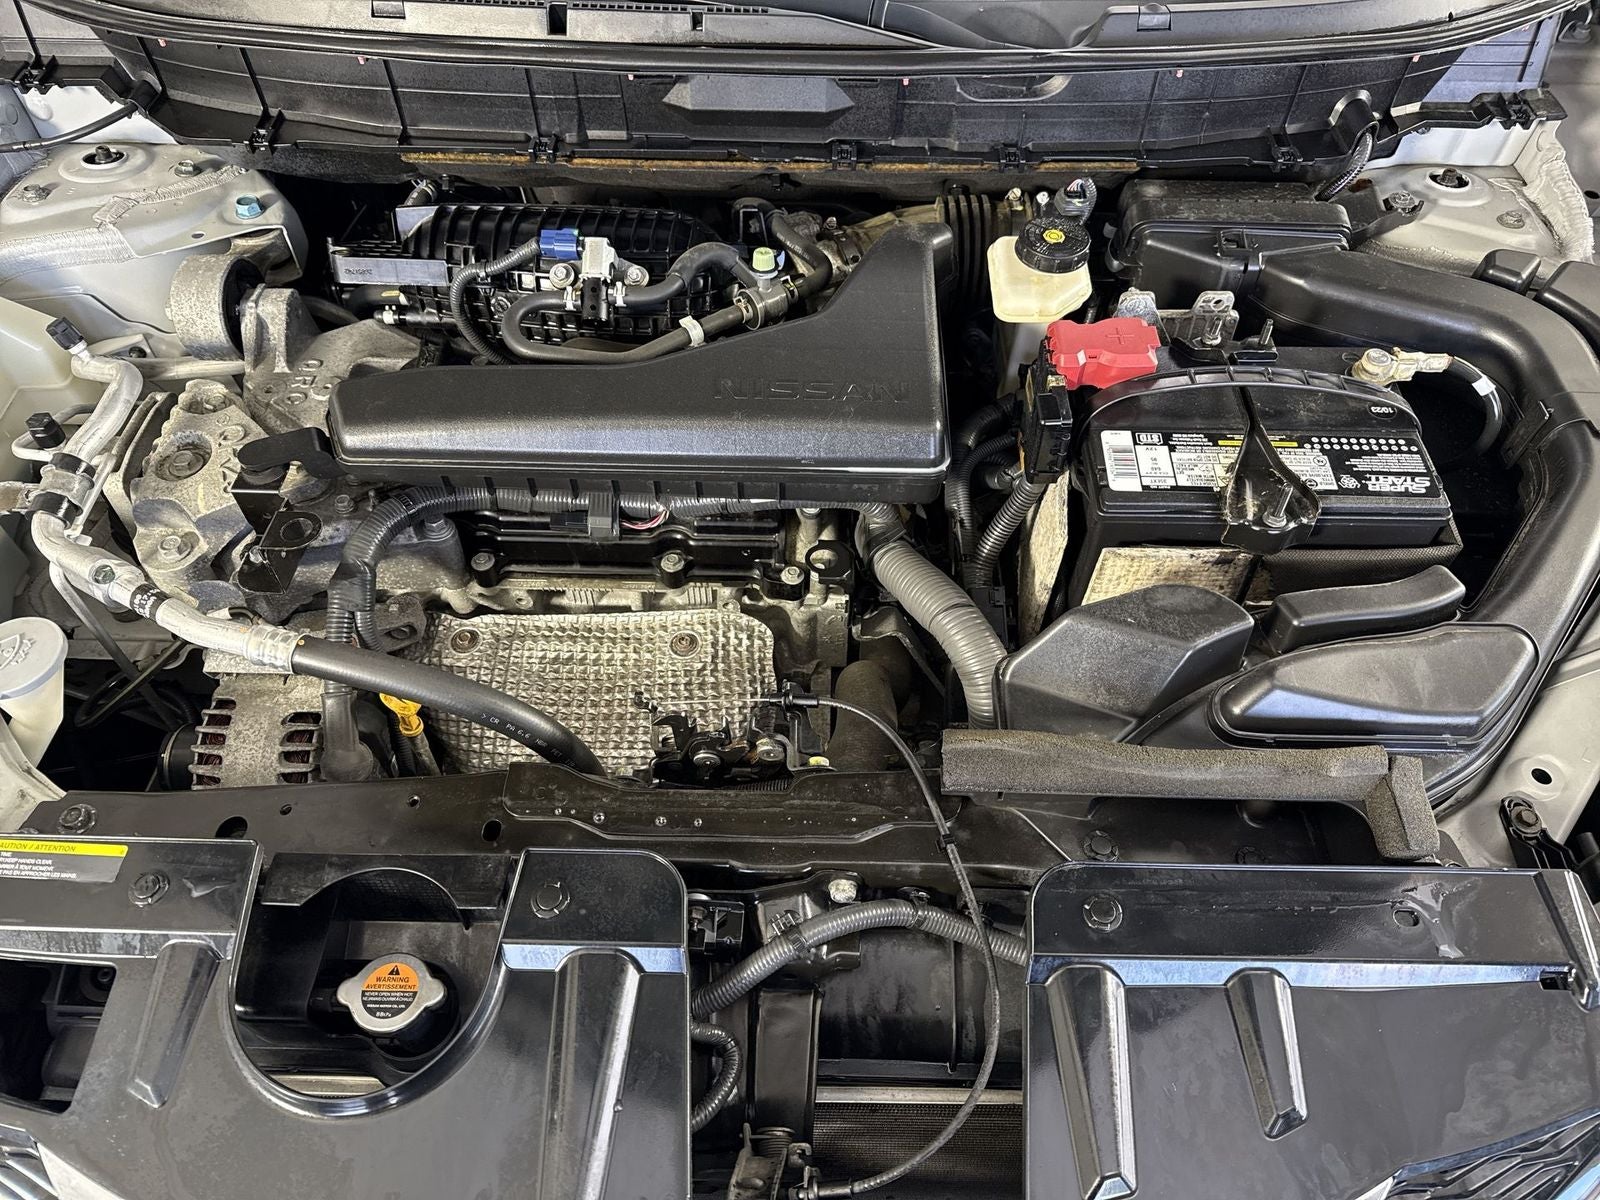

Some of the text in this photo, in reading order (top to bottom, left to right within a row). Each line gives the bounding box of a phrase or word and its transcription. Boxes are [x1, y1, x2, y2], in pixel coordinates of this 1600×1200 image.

[713, 379, 909, 403] NISSAN
[1370, 406, 1395, 415] 10/23
[1366, 475, 1431, 488] START
[1367, 483, 1427, 494] SUPER
[35, 844, 77, 852] ATTENTION
[365, 983, 417, 991] AVERTISSEMENT
